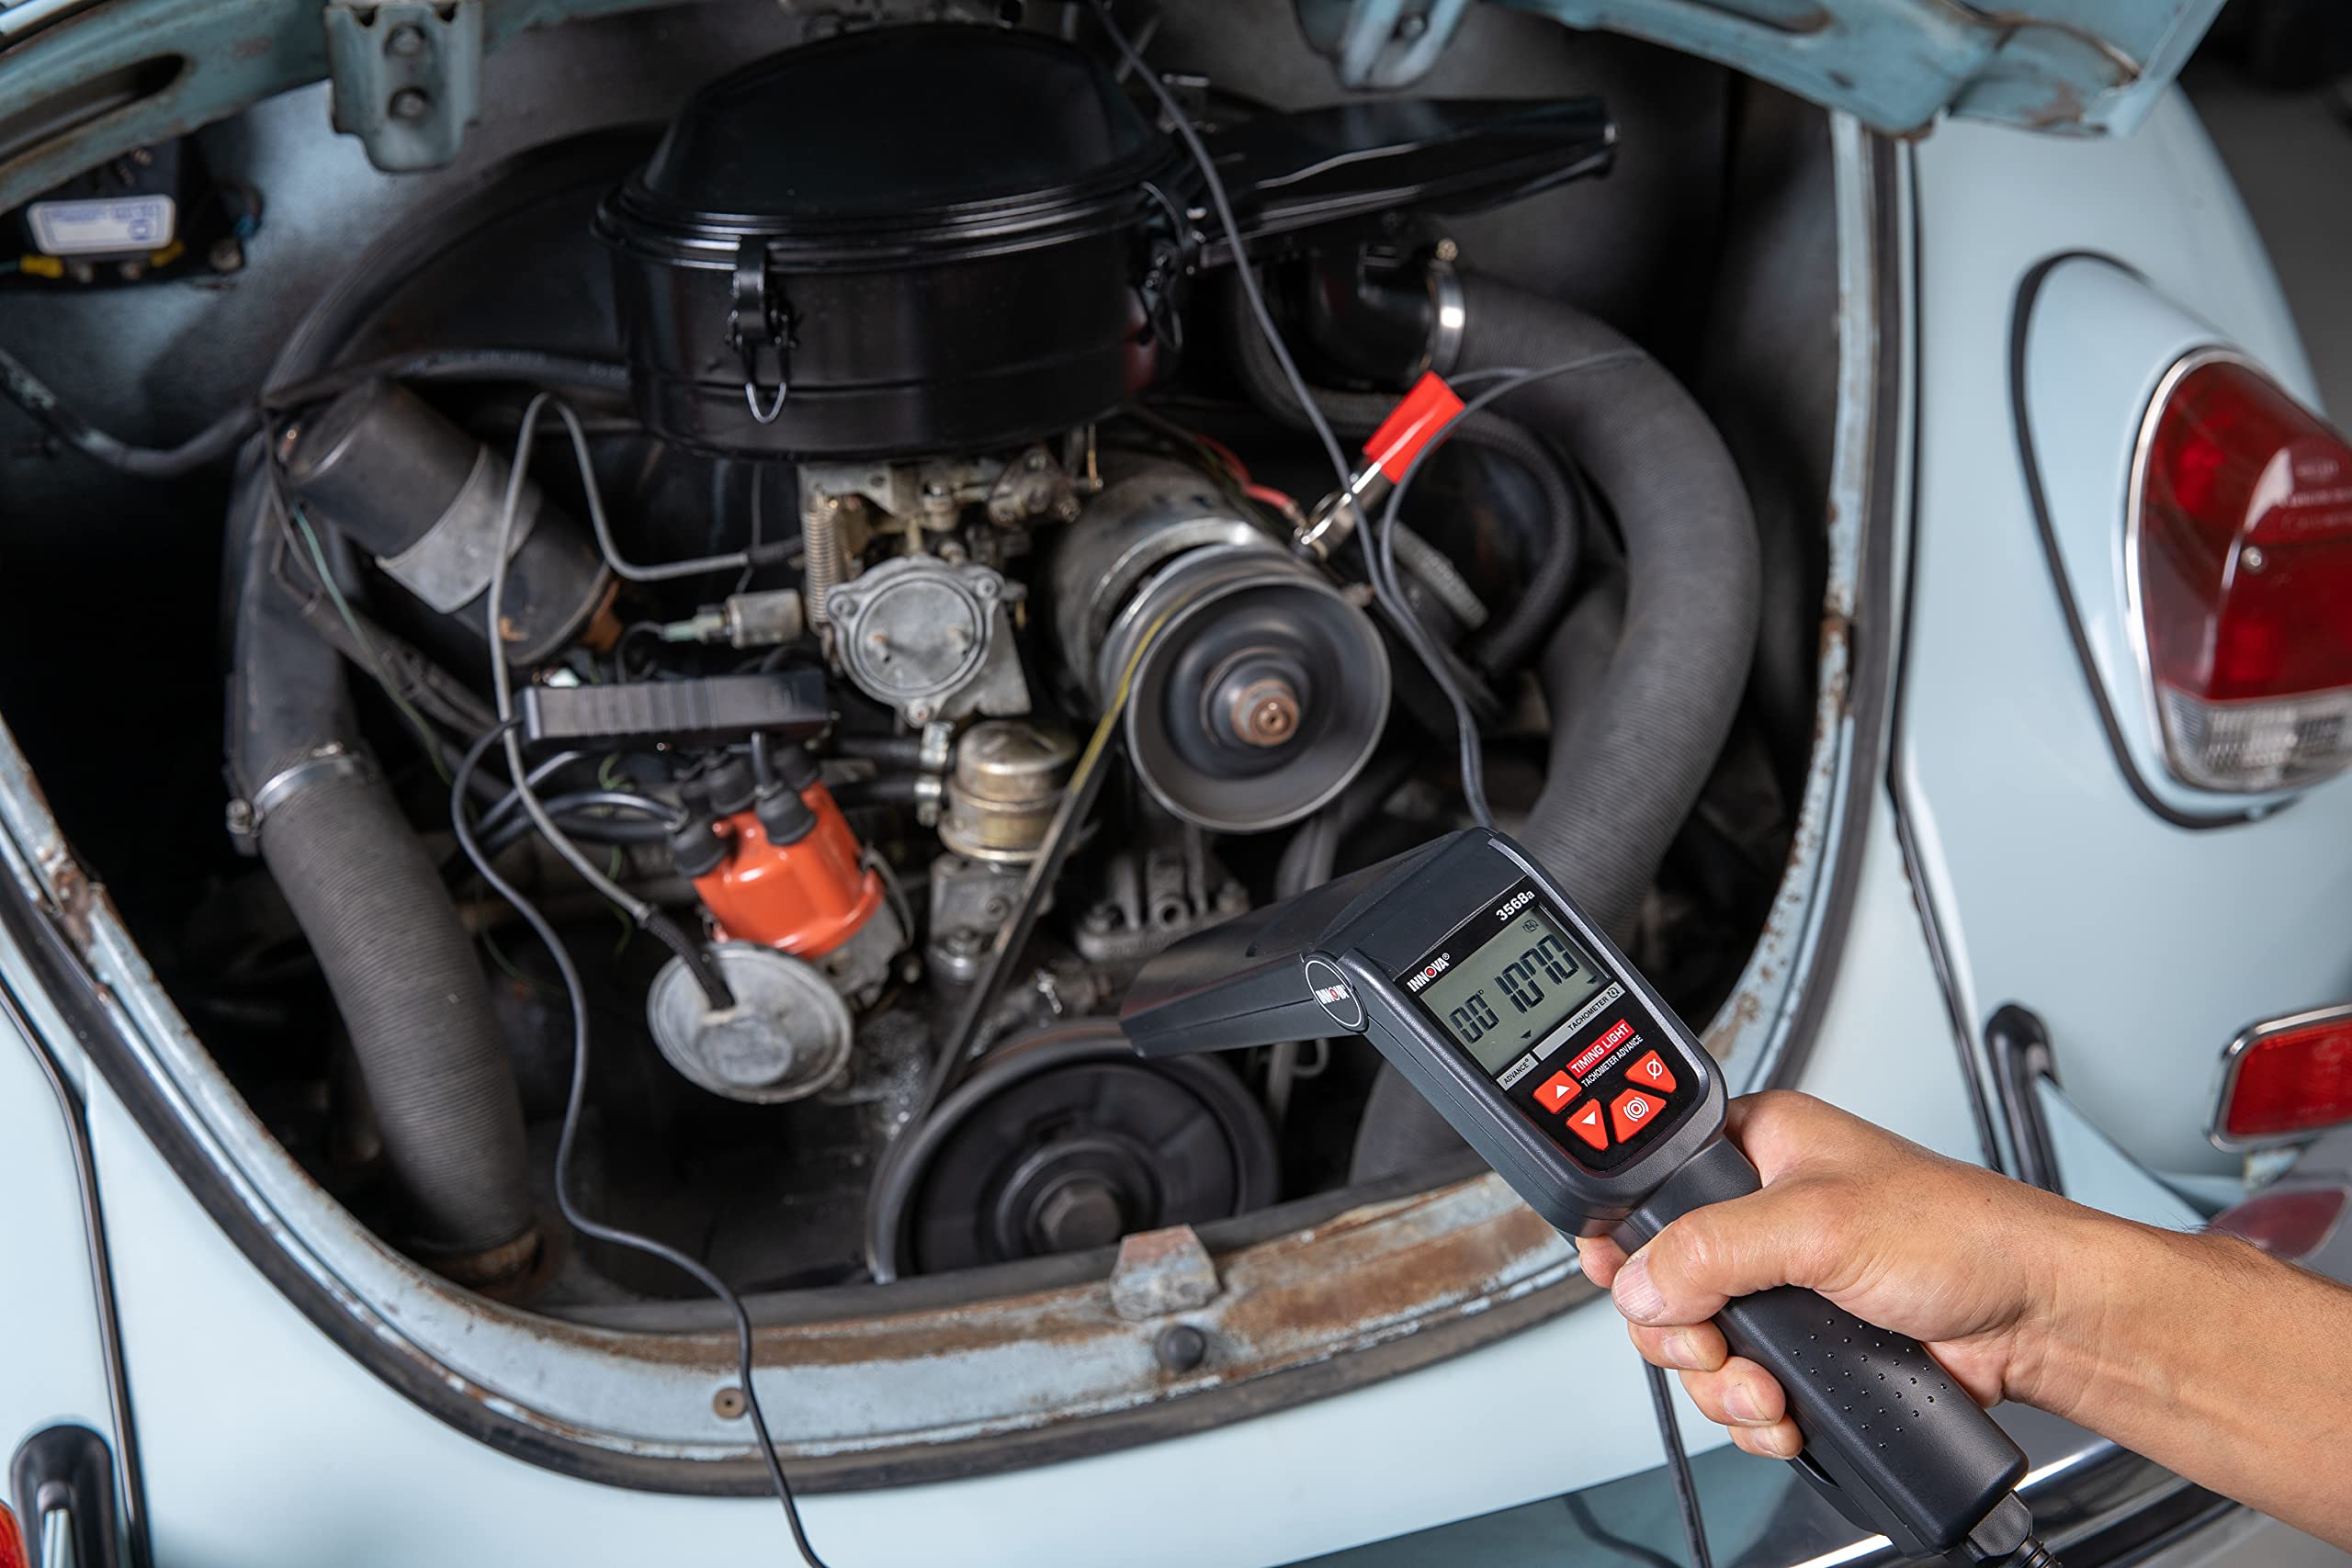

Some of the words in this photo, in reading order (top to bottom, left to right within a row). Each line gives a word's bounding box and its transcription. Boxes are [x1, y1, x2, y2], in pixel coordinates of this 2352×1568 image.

[1496, 890, 1535, 921] 3568a
[1494, 933, 1579, 1014] 1070
[1567, 996, 1609, 1032] TACHOMETER
[1570, 1044, 1605, 1074] TIMING
[1602, 1022, 1630, 1049] LIGHT
[1581, 1055, 1619, 1088] TACHOMETER
[1617, 1034, 1644, 1058] ADVANCE
